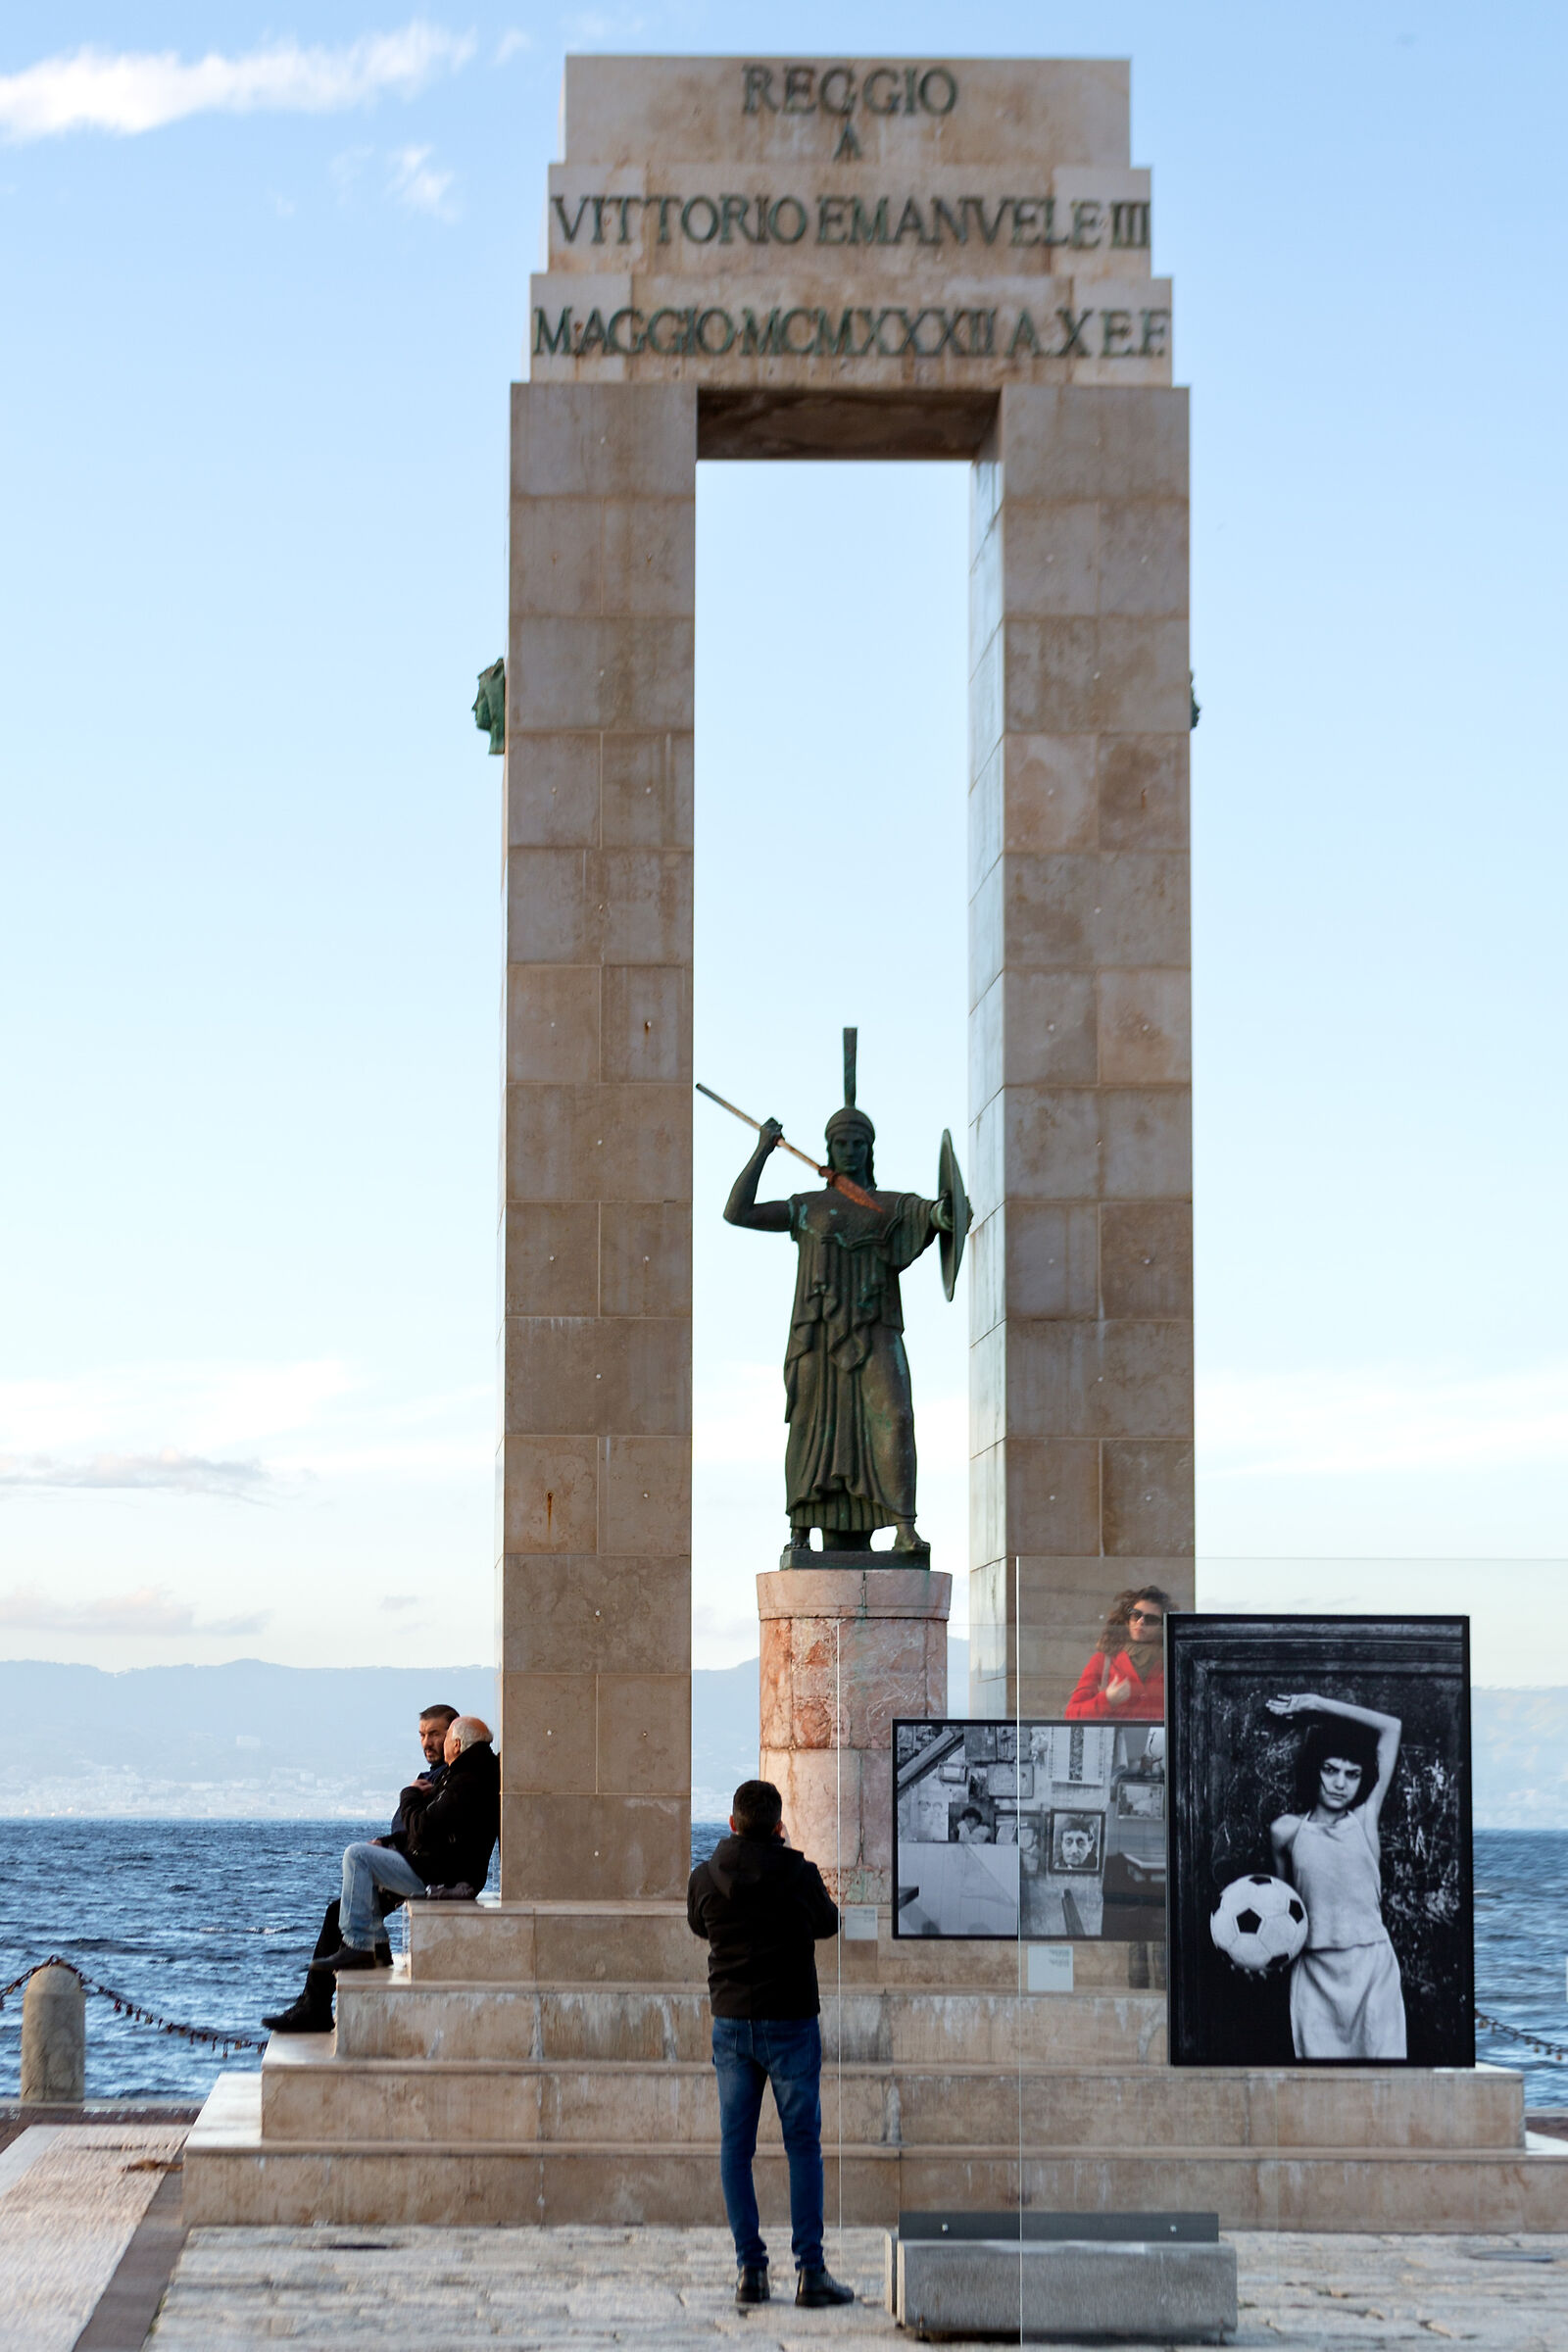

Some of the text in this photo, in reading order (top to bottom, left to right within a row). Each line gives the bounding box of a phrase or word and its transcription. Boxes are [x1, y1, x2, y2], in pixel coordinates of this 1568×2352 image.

[742, 64, 959, 117] REGGIO
[833, 122, 862, 161] A
[552, 194, 1152, 249] VITTORIO EMANVELE III
[532, 307, 734, 356] MAGGIO
